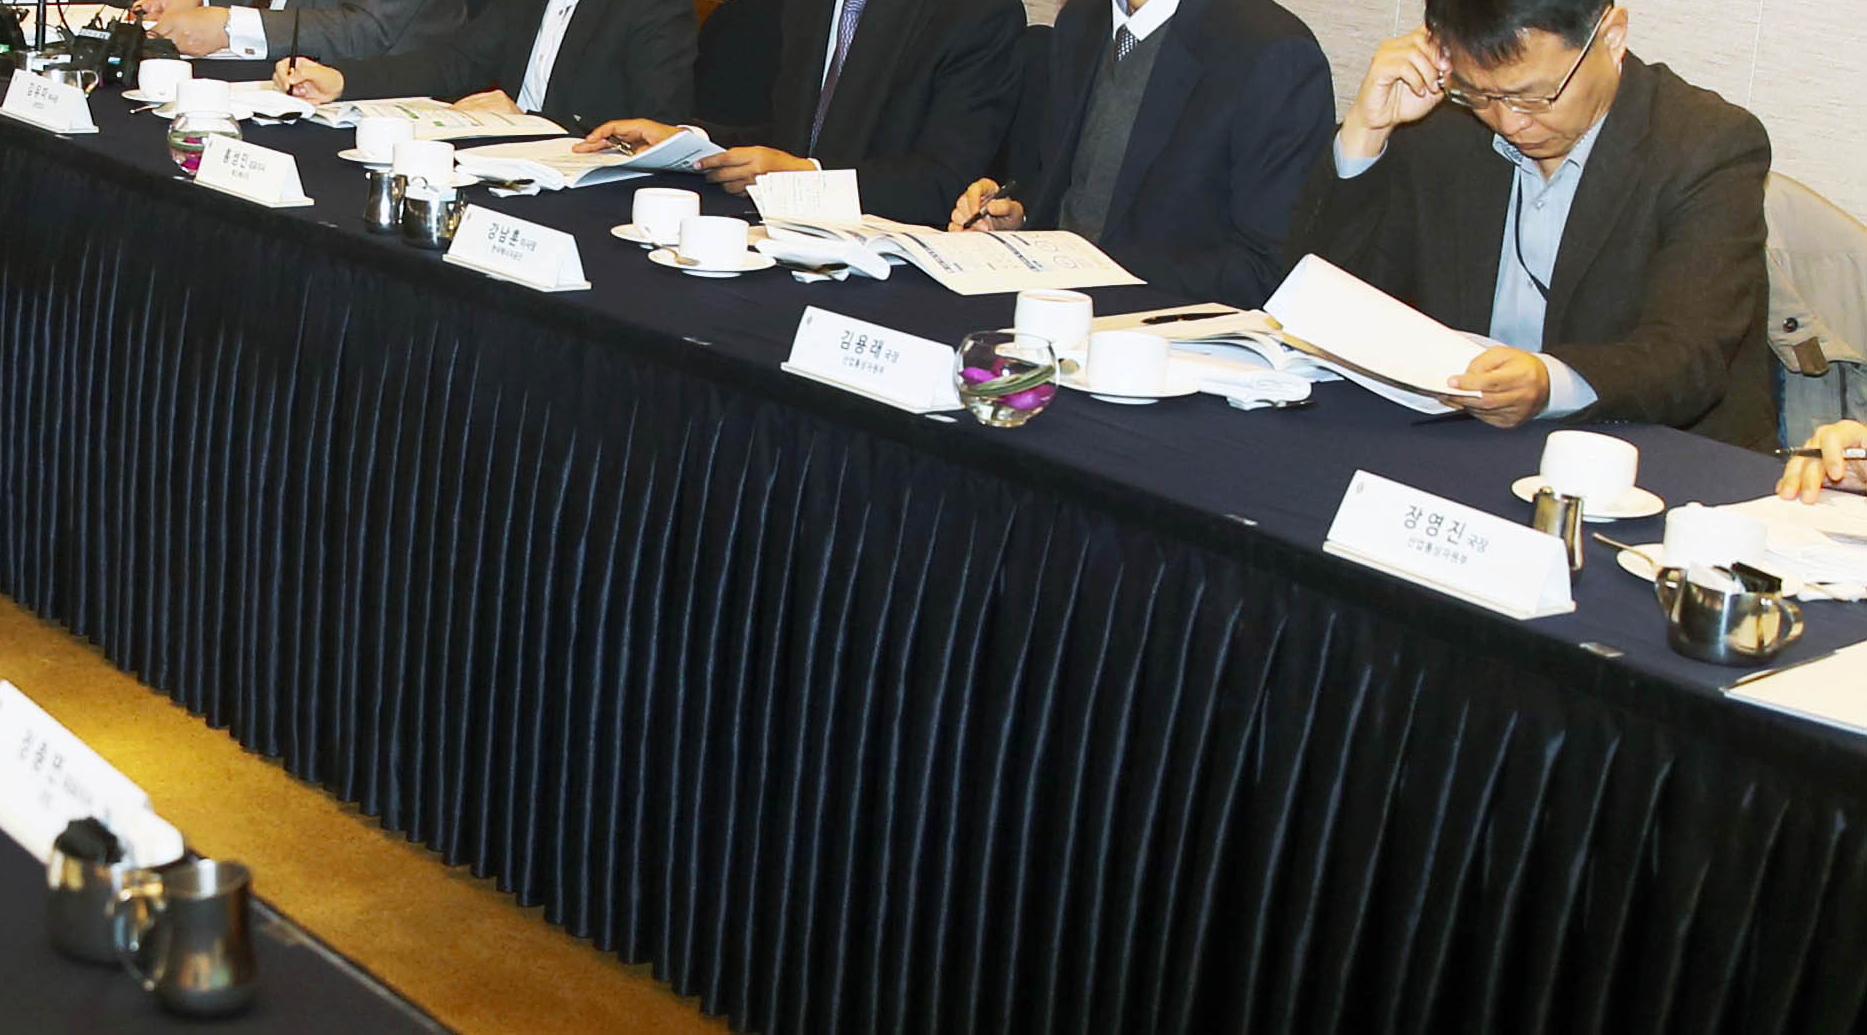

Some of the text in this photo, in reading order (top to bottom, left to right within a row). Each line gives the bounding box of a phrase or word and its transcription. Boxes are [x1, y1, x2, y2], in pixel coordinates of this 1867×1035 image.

[840, 330, 885, 360] 김용래
[1404, 504, 1490, 554] 장영진 국장
